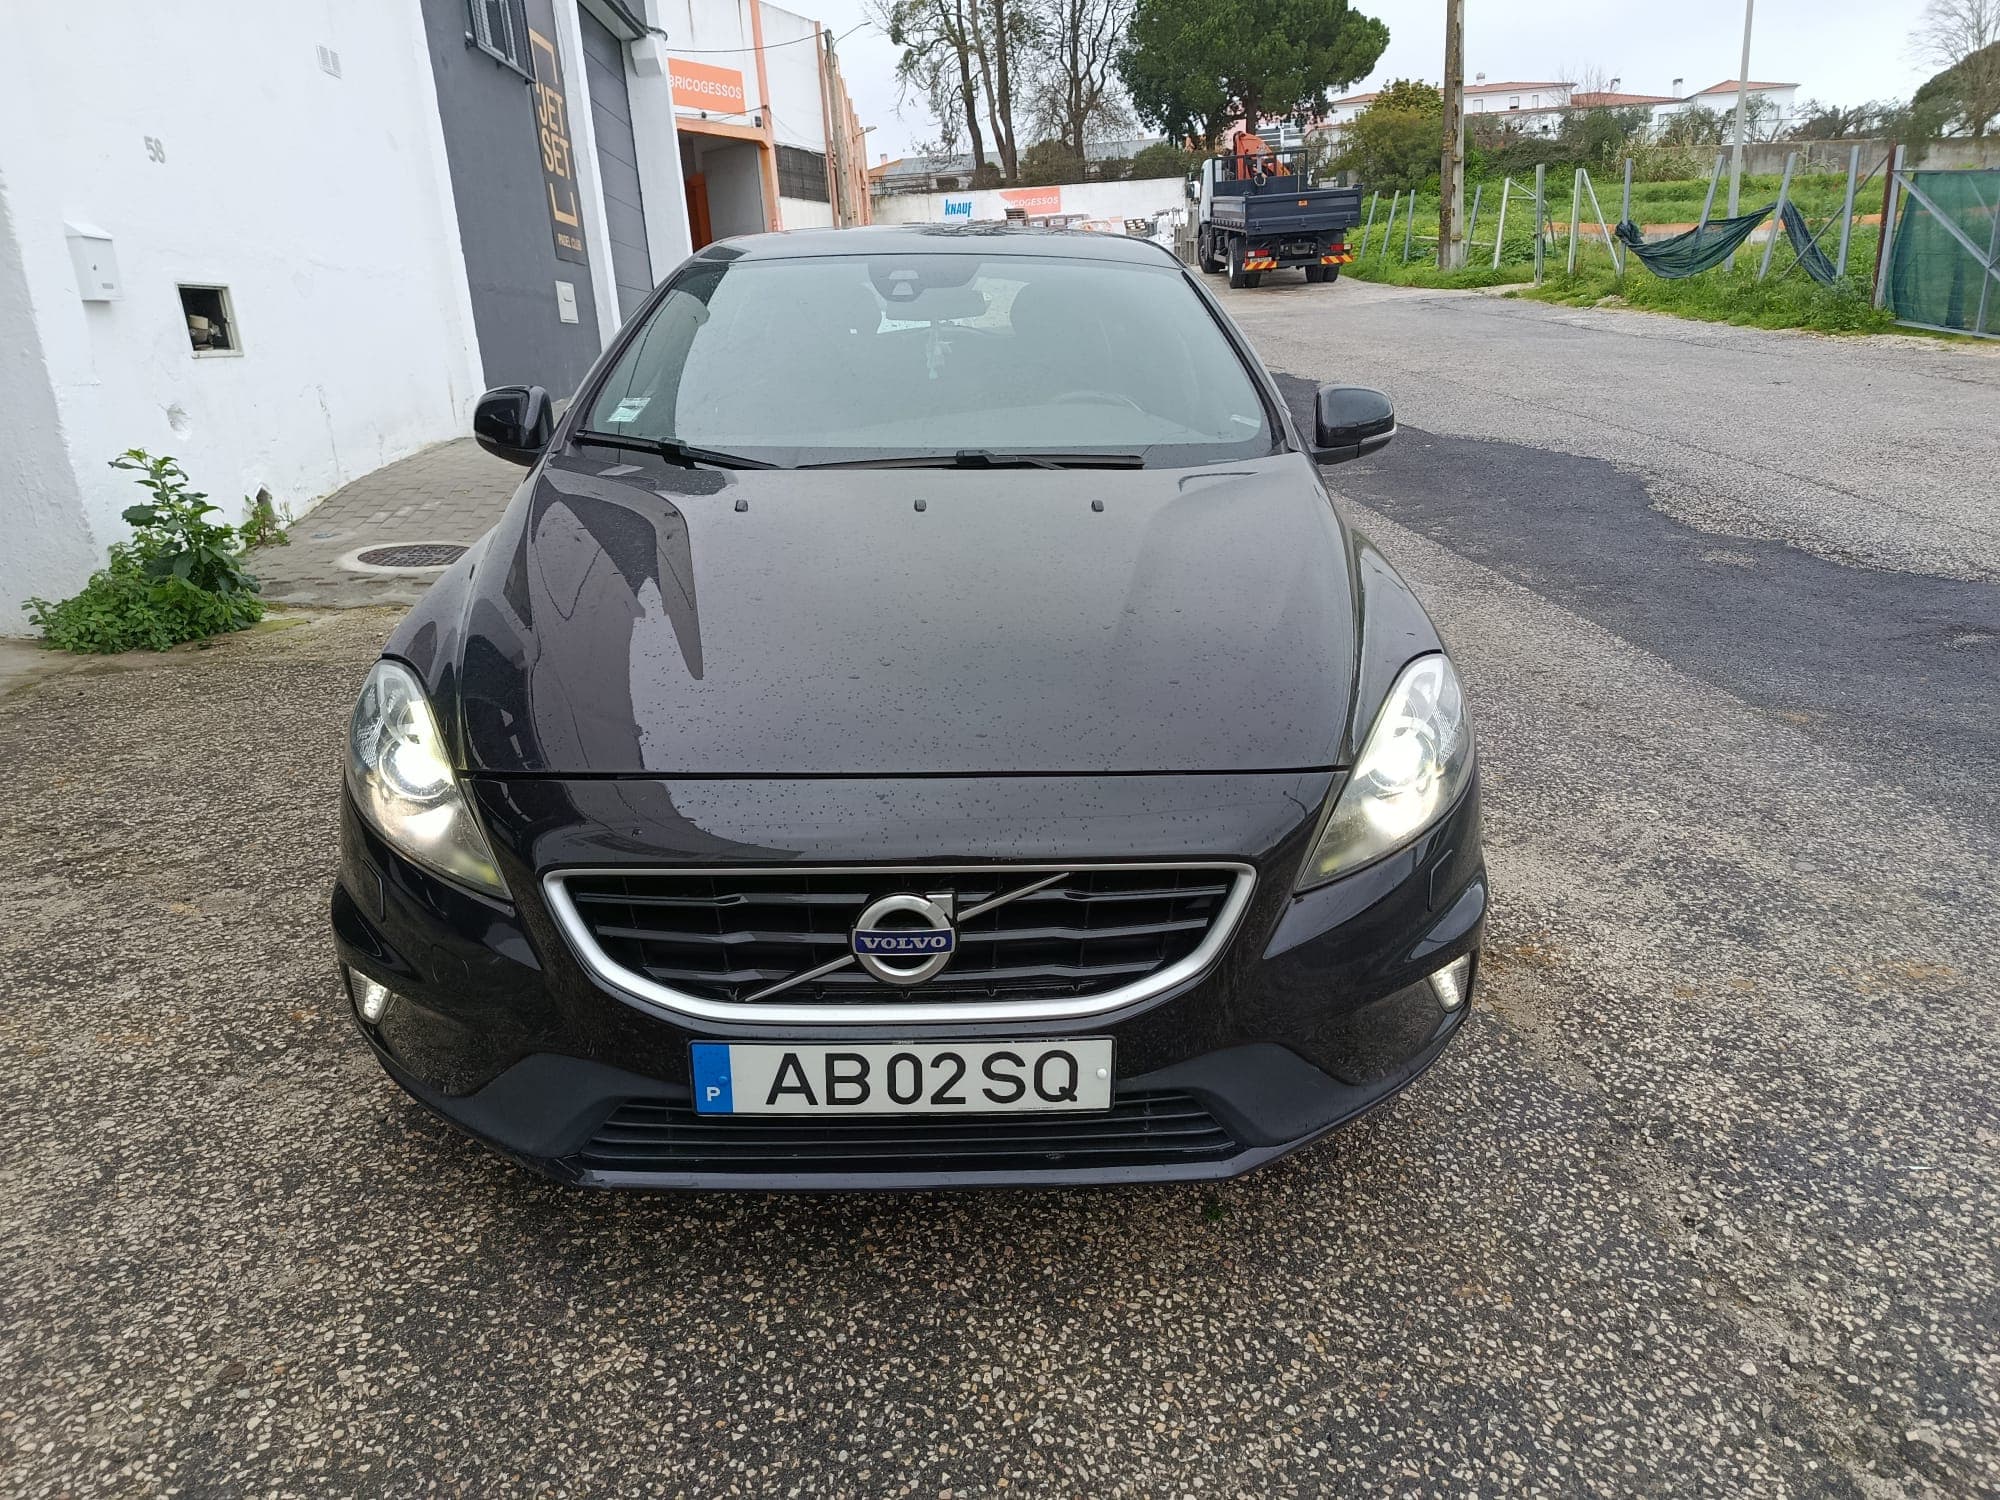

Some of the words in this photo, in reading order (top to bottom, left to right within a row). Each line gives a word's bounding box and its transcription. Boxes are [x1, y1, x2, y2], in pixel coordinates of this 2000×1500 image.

[669, 74, 742, 99] BRICOGESSOS
[539, 83, 564, 136] JET
[144, 136, 165, 163] 58
[542, 127, 570, 180] SET
[860, 936, 946, 949] VOLVO
[707, 1086, 720, 1101] P
